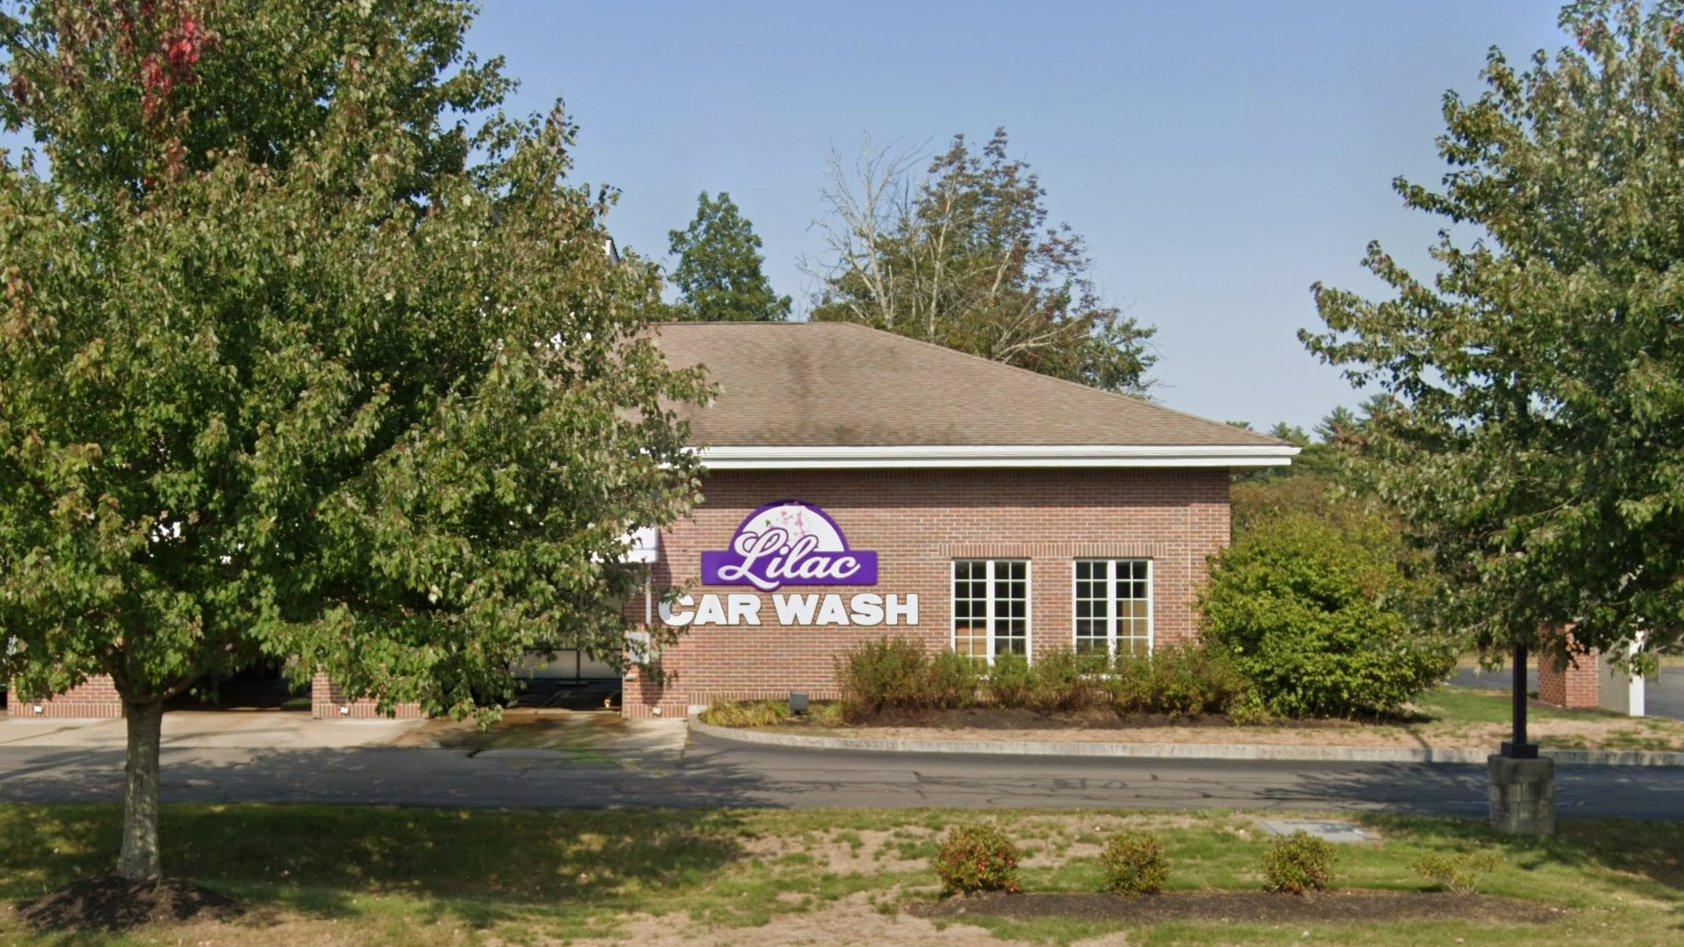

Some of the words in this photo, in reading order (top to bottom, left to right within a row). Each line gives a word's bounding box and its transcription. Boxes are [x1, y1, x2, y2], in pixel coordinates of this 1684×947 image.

[718, 528, 860, 589] Lilac
[658, 593, 762, 626] CAR
[772, 593, 919, 626] WASH
